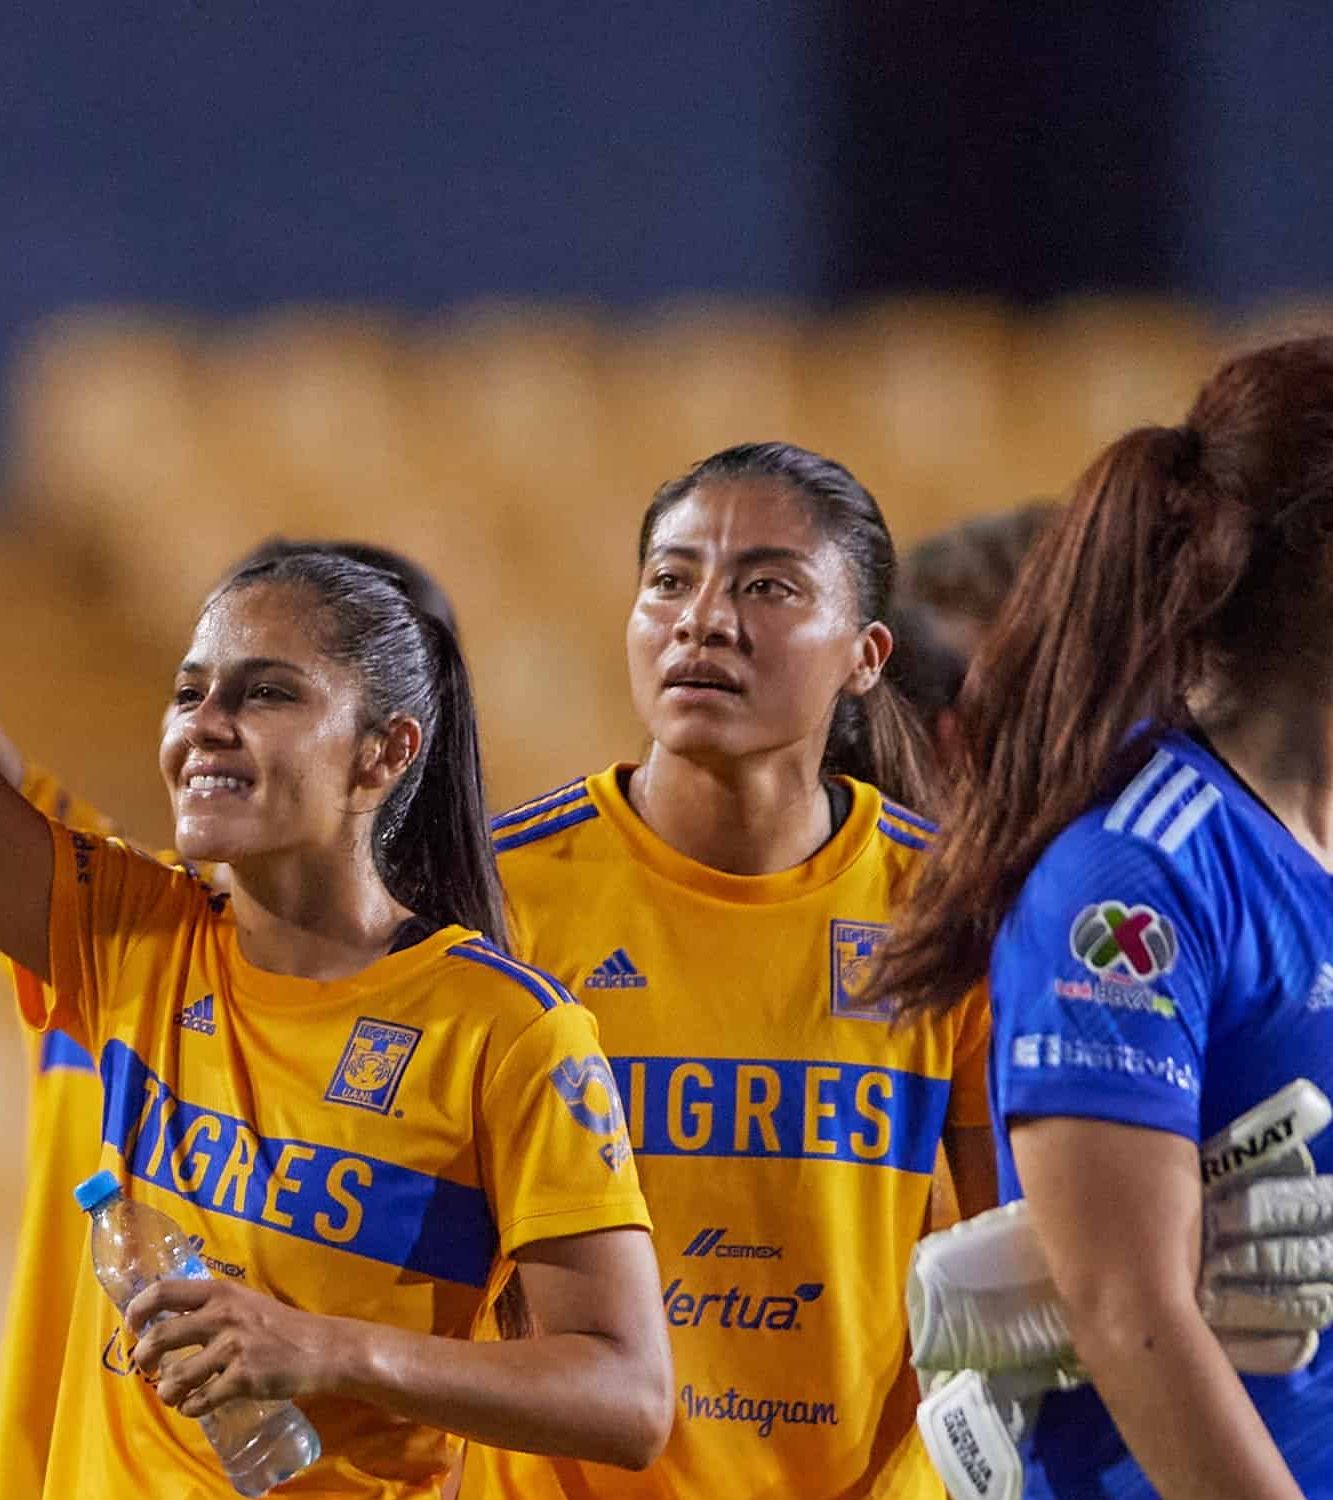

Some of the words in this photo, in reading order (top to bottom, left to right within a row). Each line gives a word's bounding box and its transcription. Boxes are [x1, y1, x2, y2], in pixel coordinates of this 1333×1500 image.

[629, 1061, 894, 1161] IGRES
[1201, 1111, 1296, 1184] RINAT
[126, 1078, 374, 1243] TIGRES
[680, 1383, 839, 1438] Instagram
